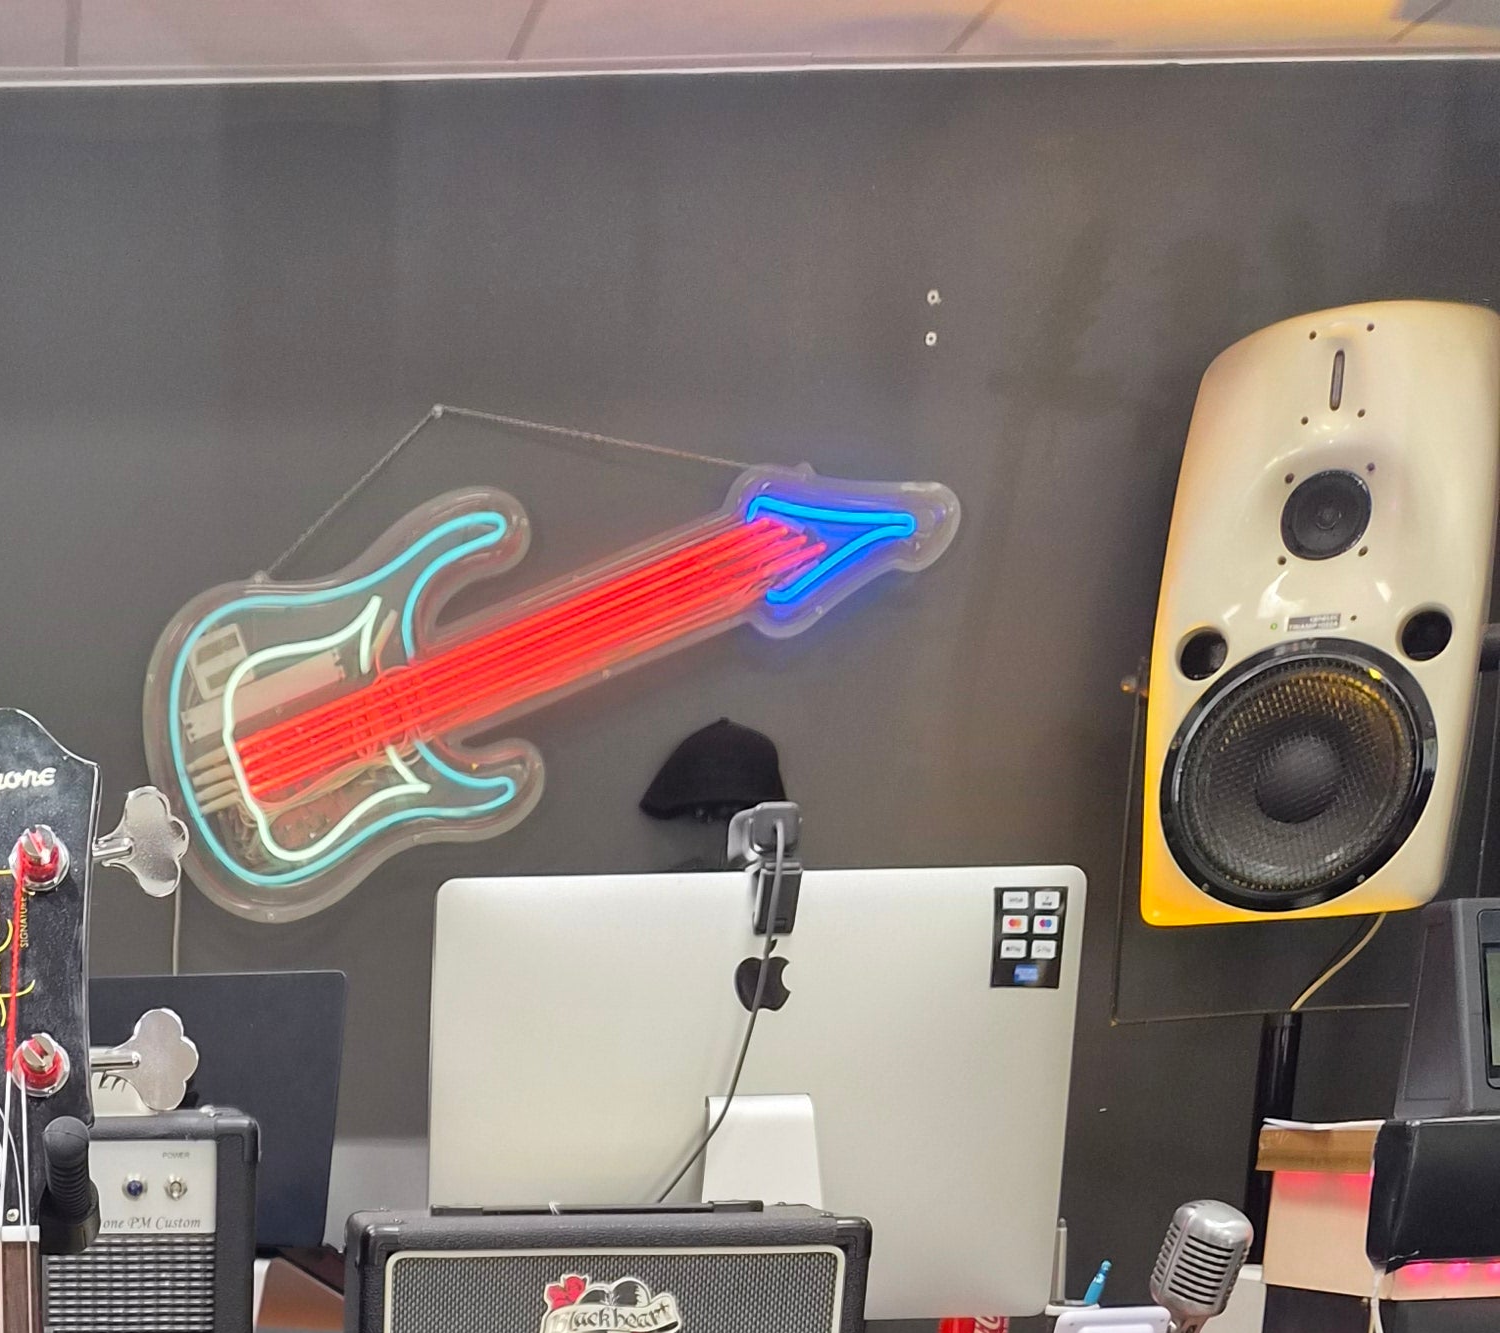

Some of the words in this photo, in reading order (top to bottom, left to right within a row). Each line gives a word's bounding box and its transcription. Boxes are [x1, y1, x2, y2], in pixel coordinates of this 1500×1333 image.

[103, 1220, 124, 1229] one
[129, 1217, 152, 1229] PM
[155, 1216, 201, 1230] Custom
